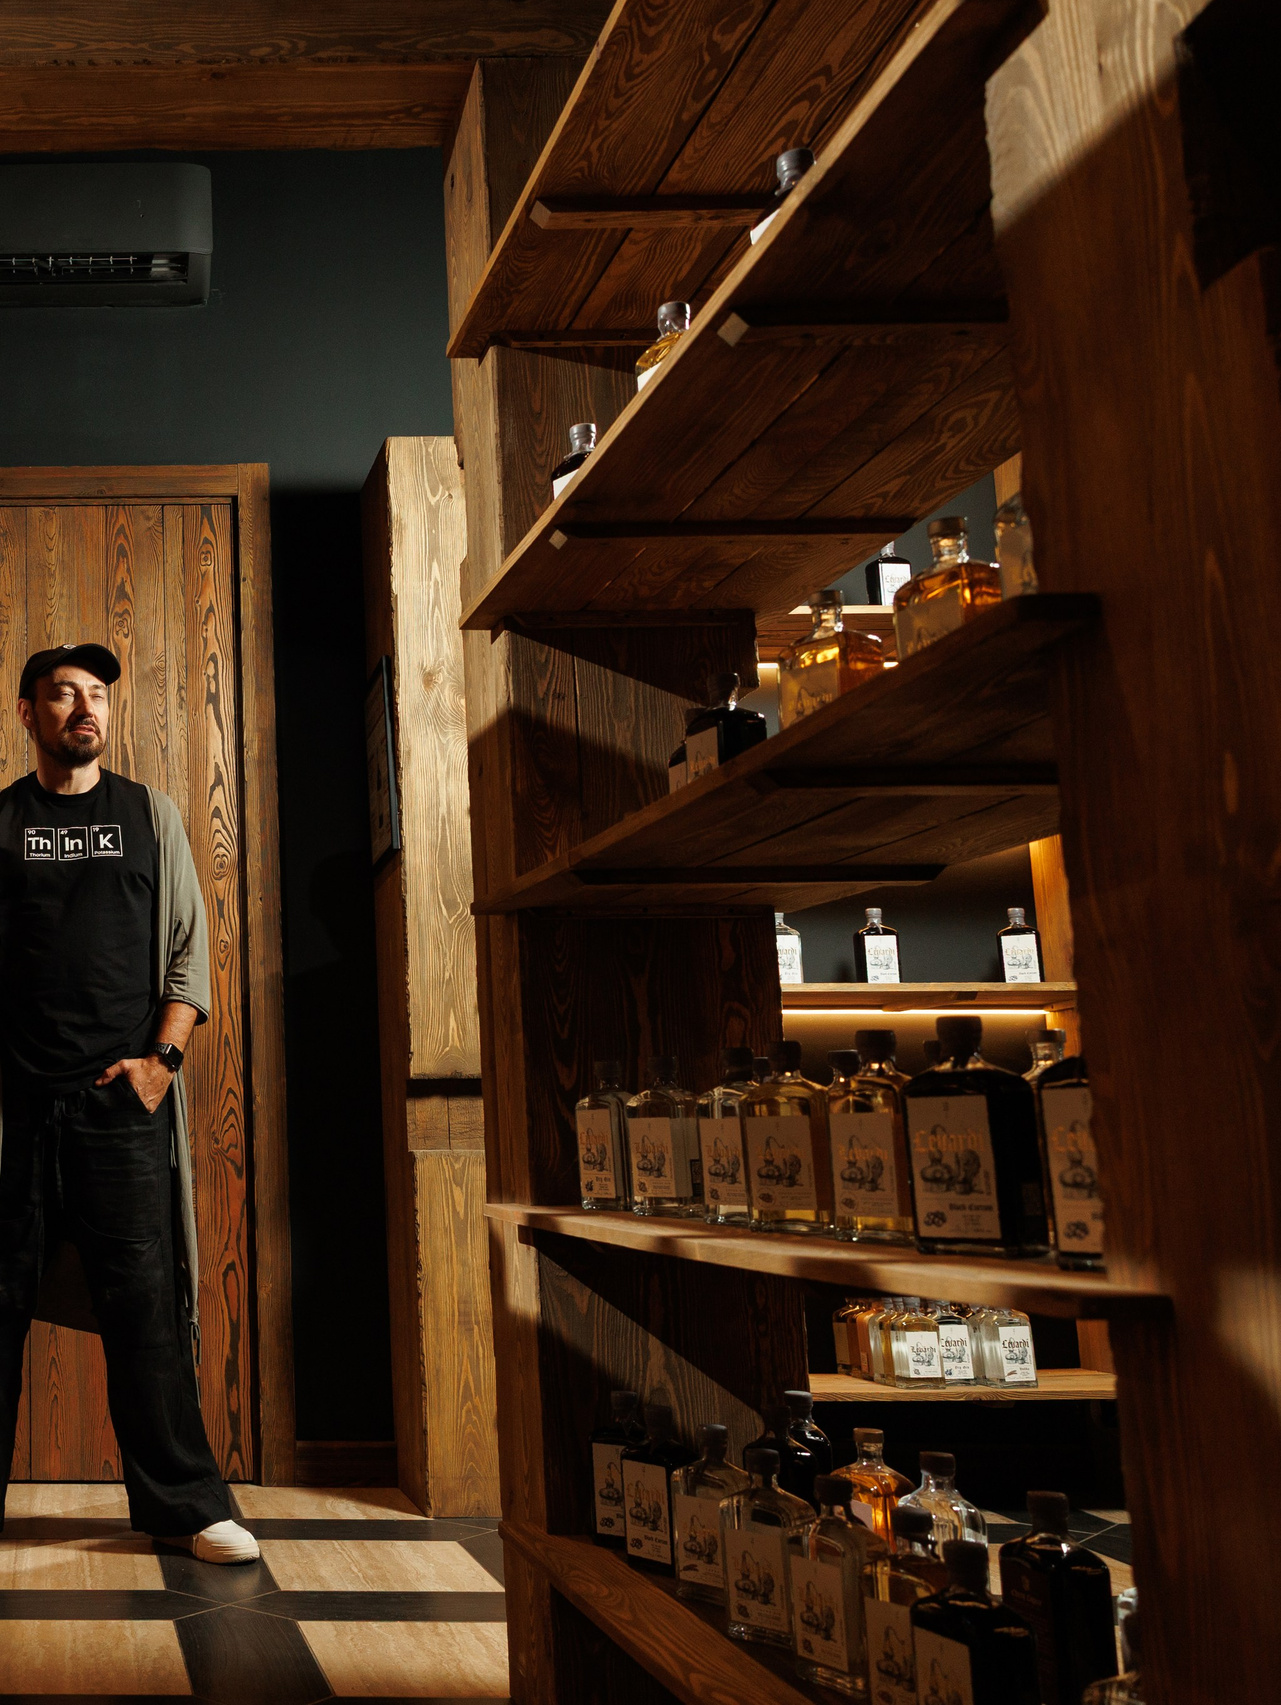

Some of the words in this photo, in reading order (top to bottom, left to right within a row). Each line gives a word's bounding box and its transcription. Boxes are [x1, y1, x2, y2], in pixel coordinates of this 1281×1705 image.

[27, 837, 51, 850] Th
[64, 837, 83, 851] In
[99, 833, 114, 849] K
[1002, 1338, 1030, 1349] Levardi
